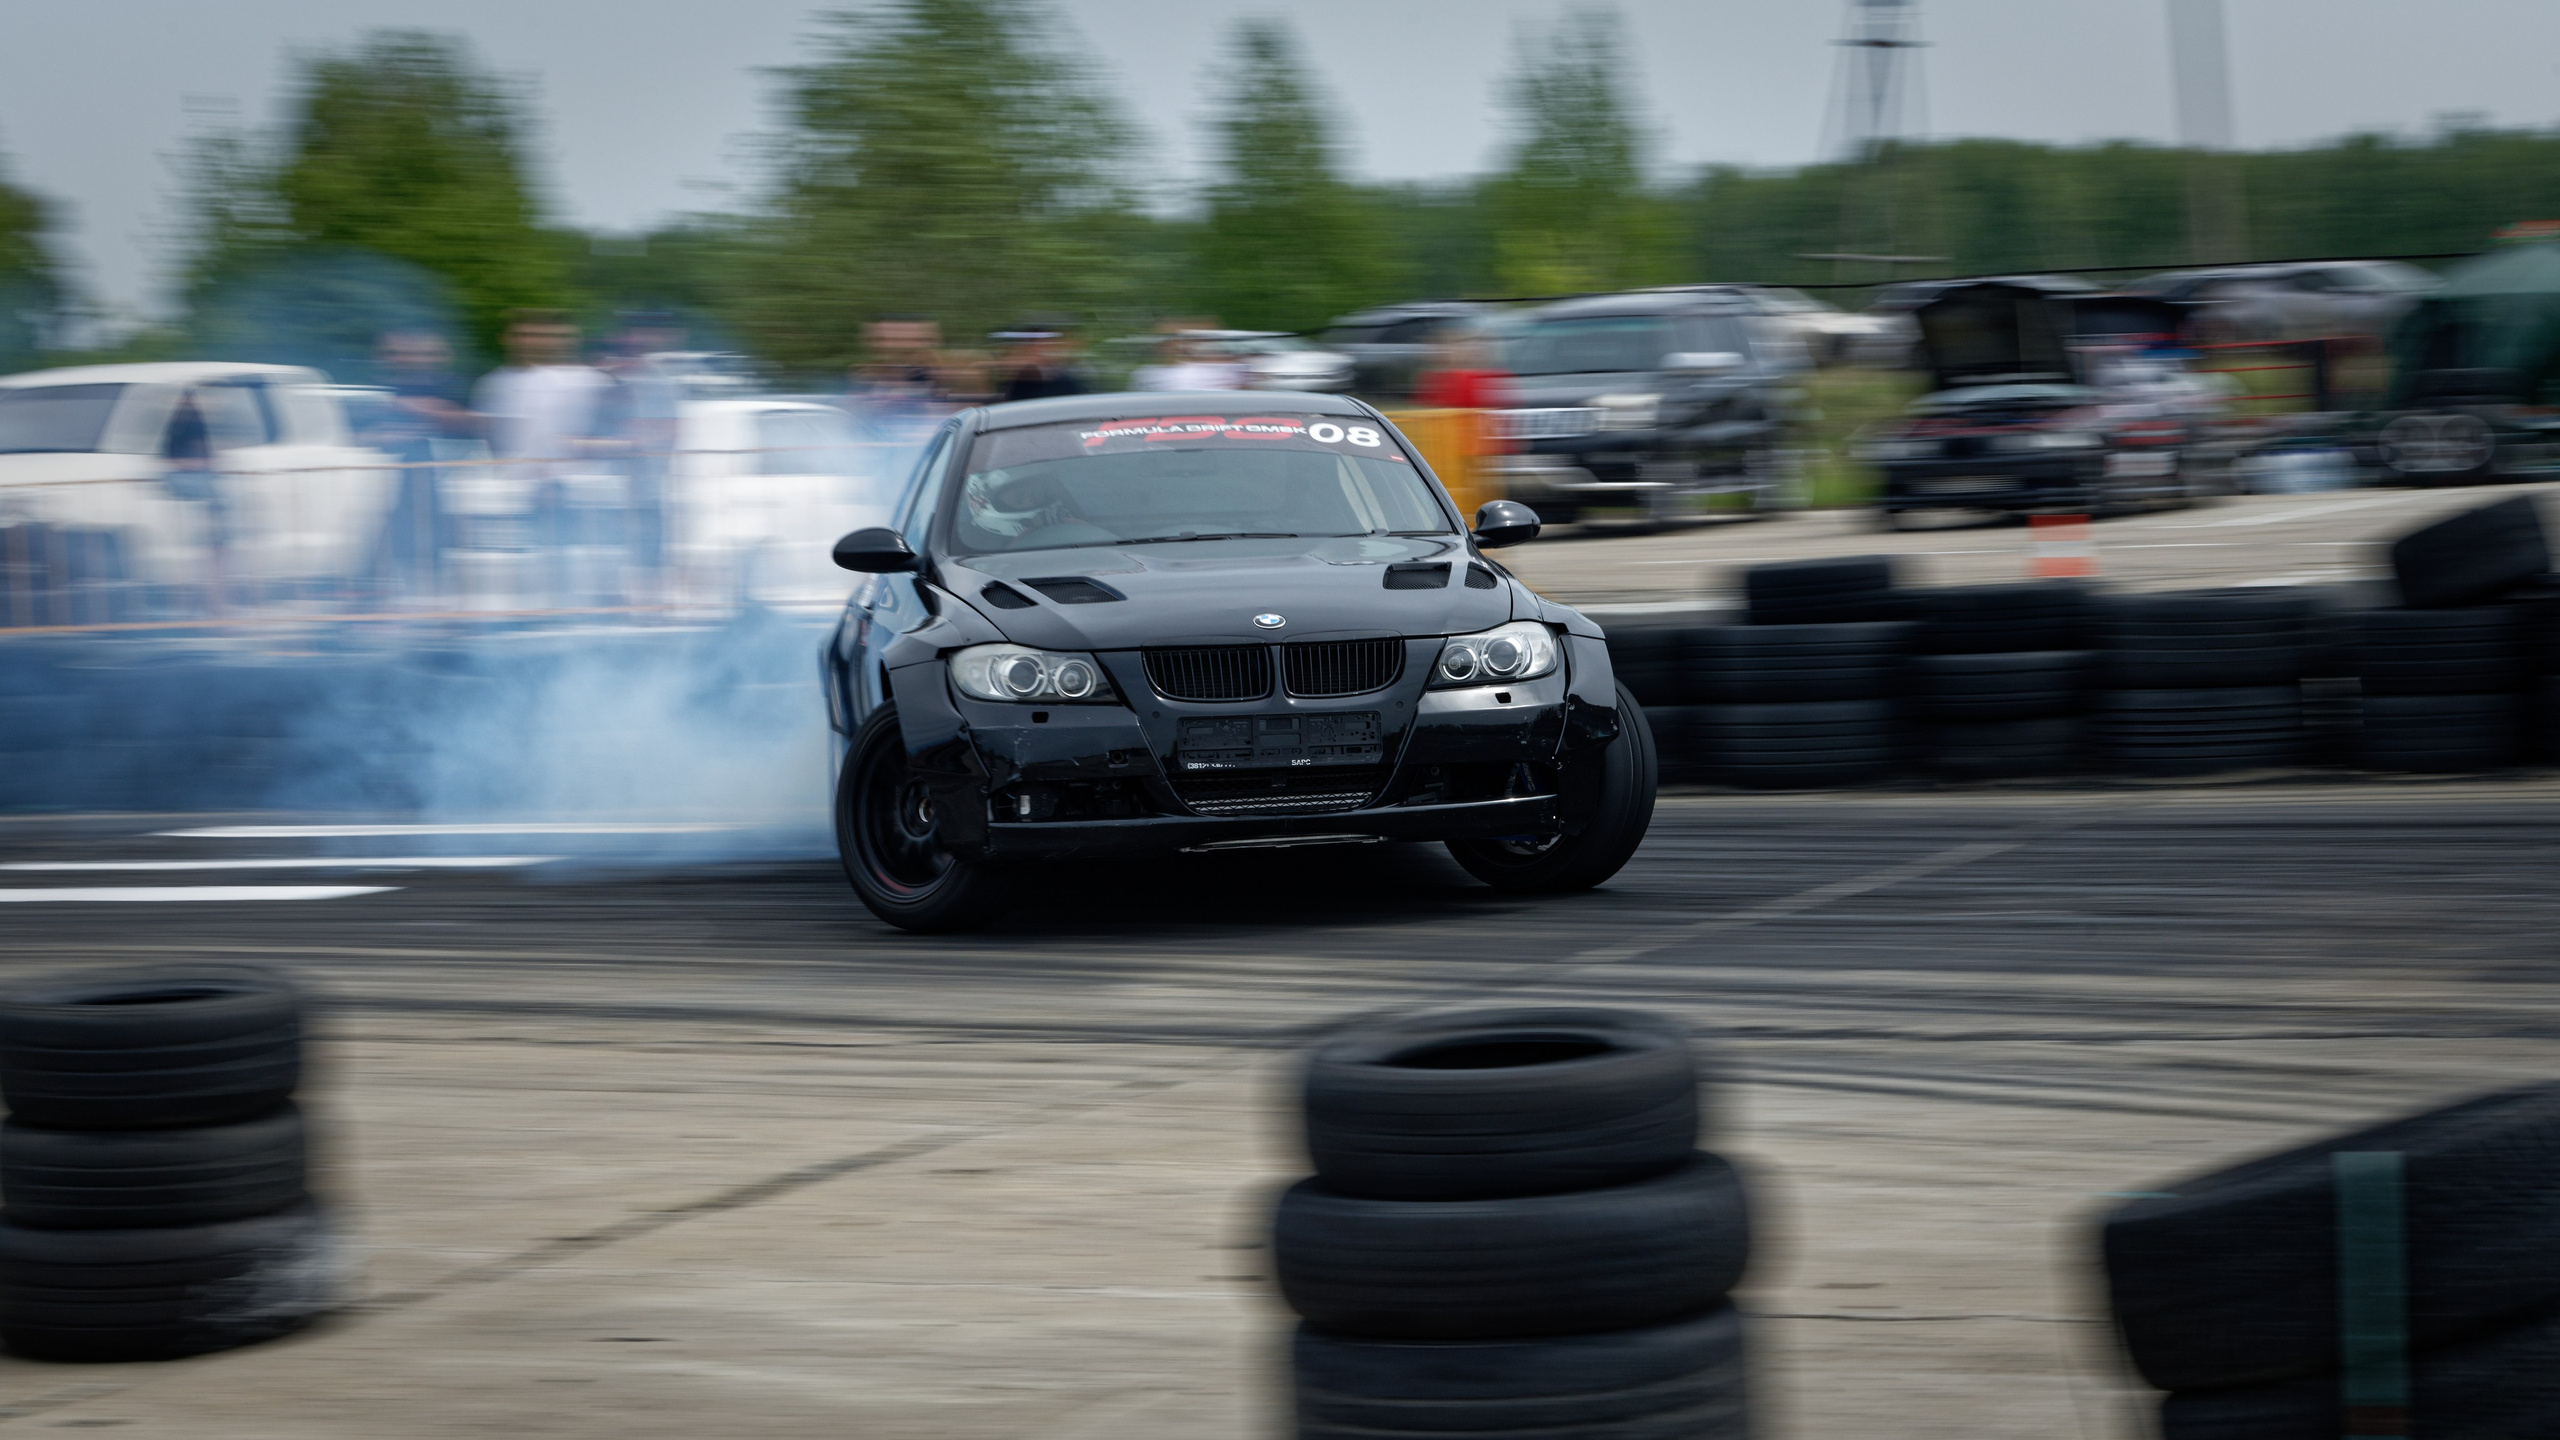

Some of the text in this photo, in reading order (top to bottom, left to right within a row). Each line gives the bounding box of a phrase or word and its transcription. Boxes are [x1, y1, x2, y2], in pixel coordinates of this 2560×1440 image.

[1080, 424, 1184, 440] FORMULA
[1185, 424, 1243, 432] DRIFT
[1308, 422, 1381, 448] 08
